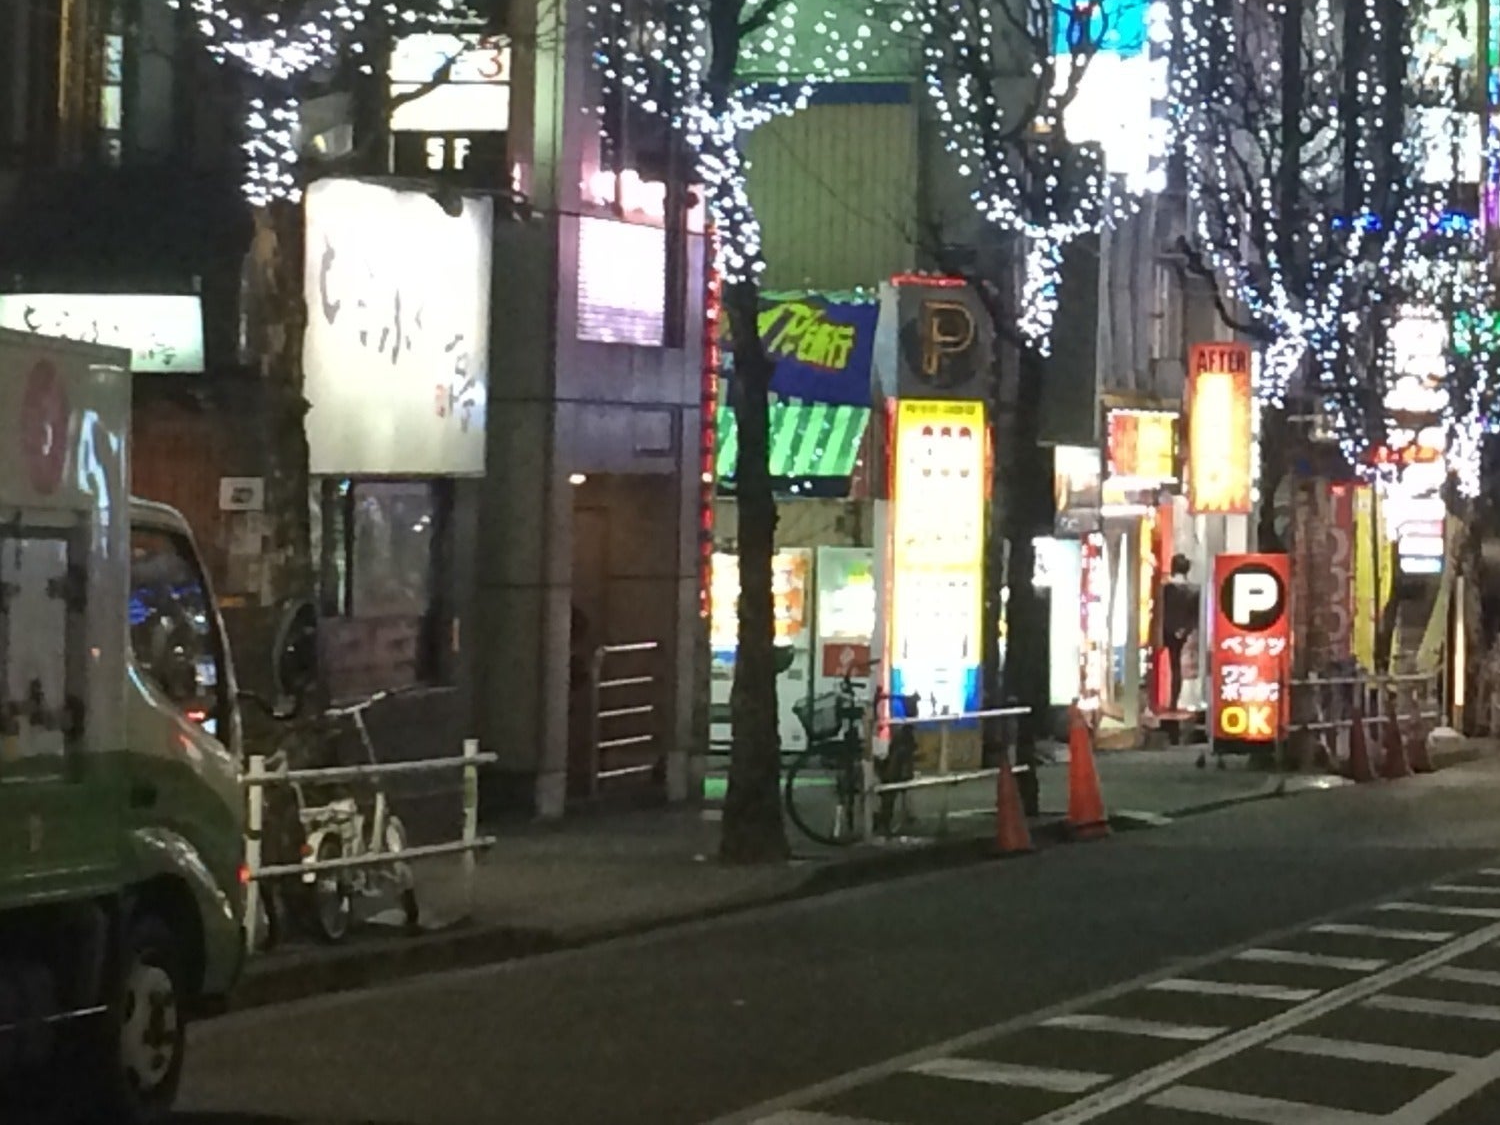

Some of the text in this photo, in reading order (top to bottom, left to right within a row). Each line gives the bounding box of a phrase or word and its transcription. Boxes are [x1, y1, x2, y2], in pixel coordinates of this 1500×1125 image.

[920, 299, 976, 376] P
[1195, 348, 1247, 374] AFTER
[1233, 572, 1278, 625] P
[1220, 705, 1273, 735] OK
